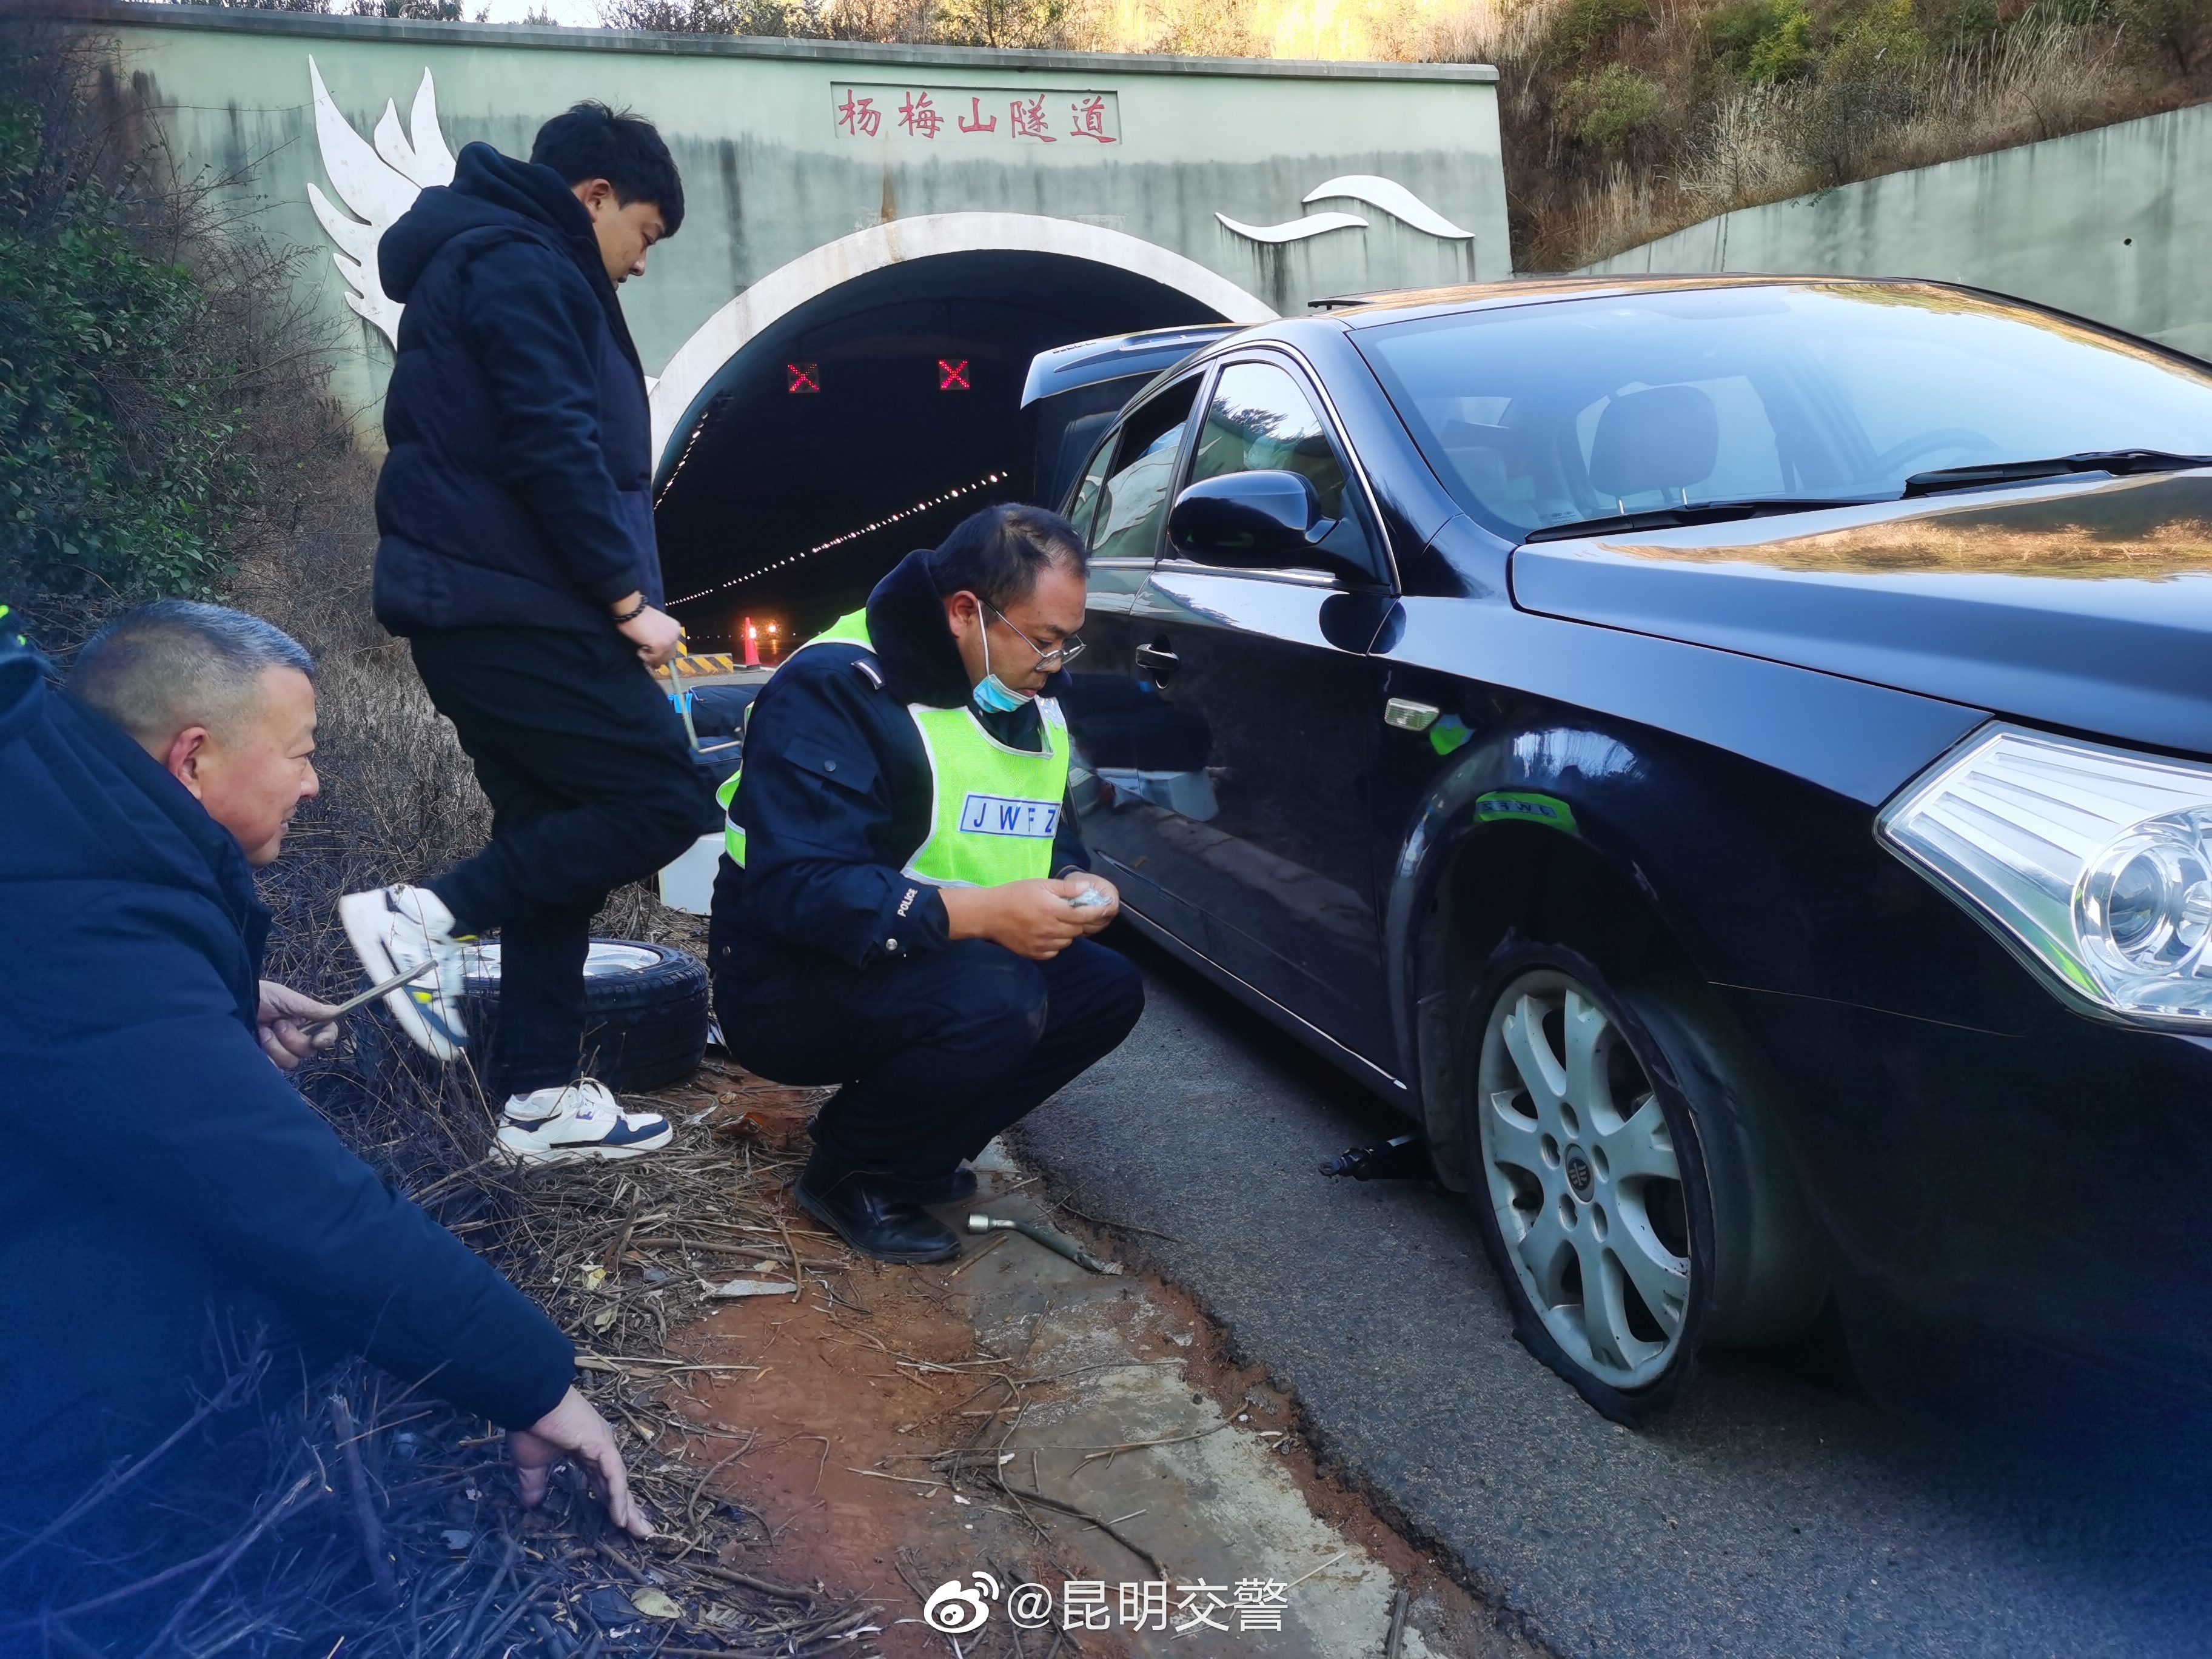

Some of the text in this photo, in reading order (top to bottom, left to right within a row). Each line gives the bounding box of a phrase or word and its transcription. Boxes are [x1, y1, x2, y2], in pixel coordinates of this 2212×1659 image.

[839, 89, 1117, 143] 杨梅山隧道
[973, 802, 1056, 833] JWFZ
[897, 887, 918, 917] POLICE
